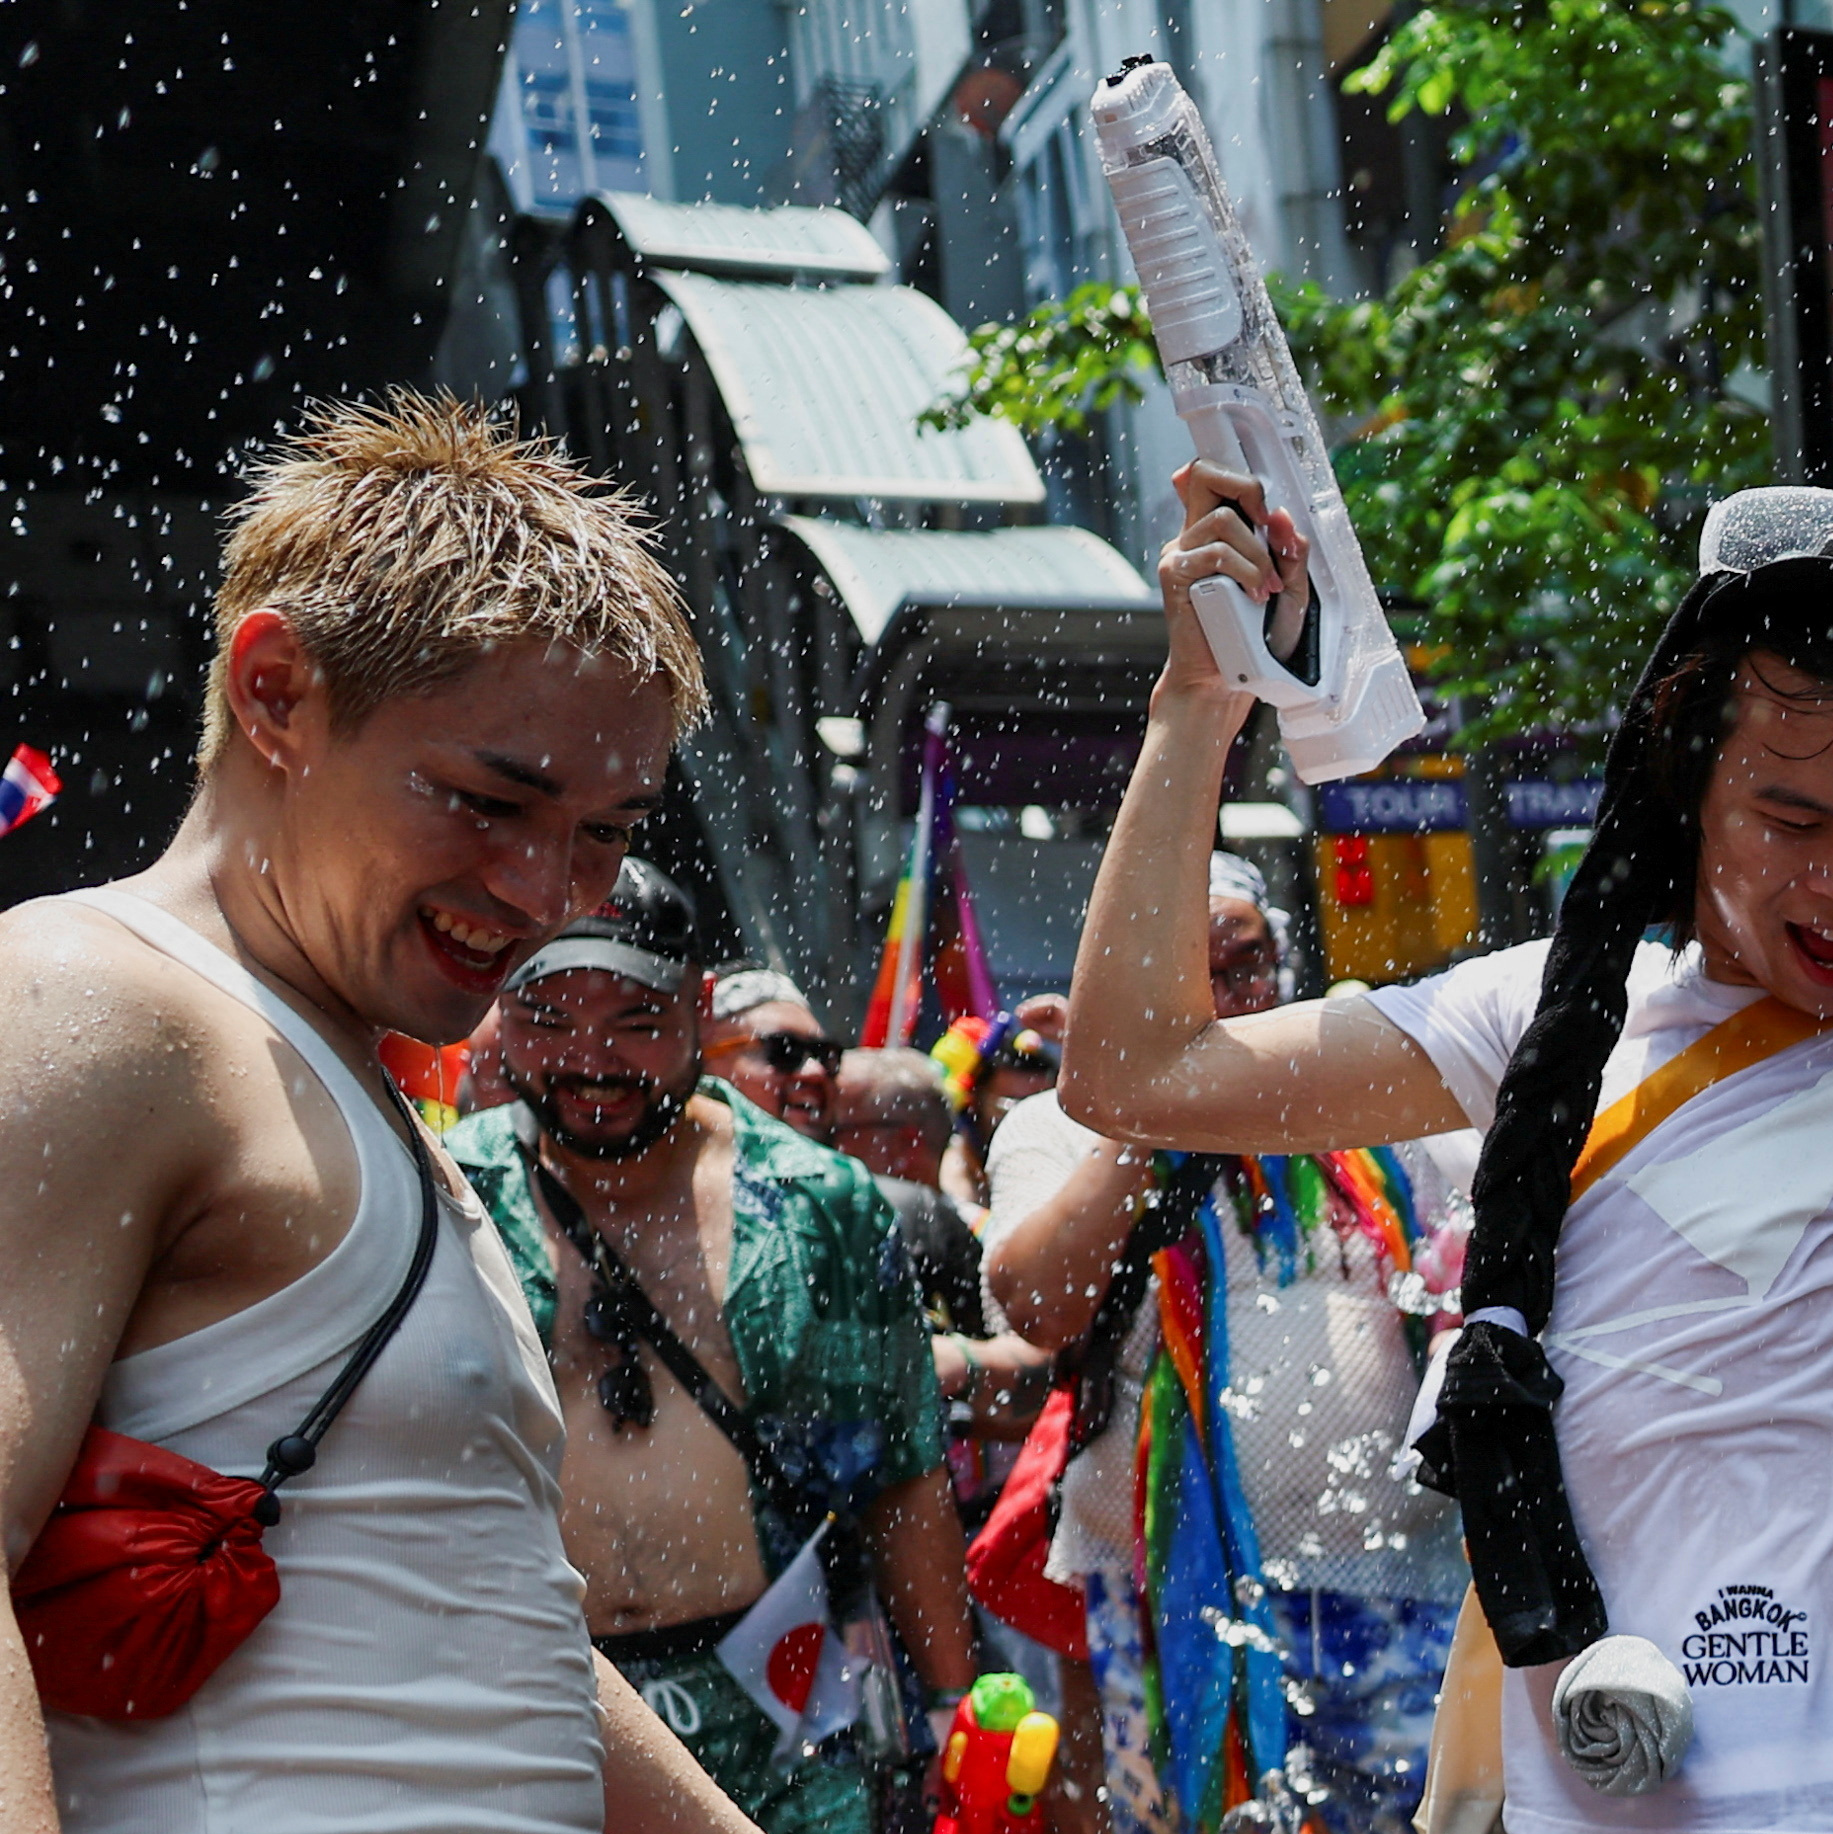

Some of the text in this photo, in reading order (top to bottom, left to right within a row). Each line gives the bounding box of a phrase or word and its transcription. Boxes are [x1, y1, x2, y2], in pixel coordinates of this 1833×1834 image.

[1346, 785, 1458, 825] TOUR
[1506, 783, 1604, 824] TRAV
[1726, 1585, 1773, 1600] WANNA
[1682, 1631, 1808, 1660] GENTLE
[1682, 1660, 1809, 1688] WOMAN
